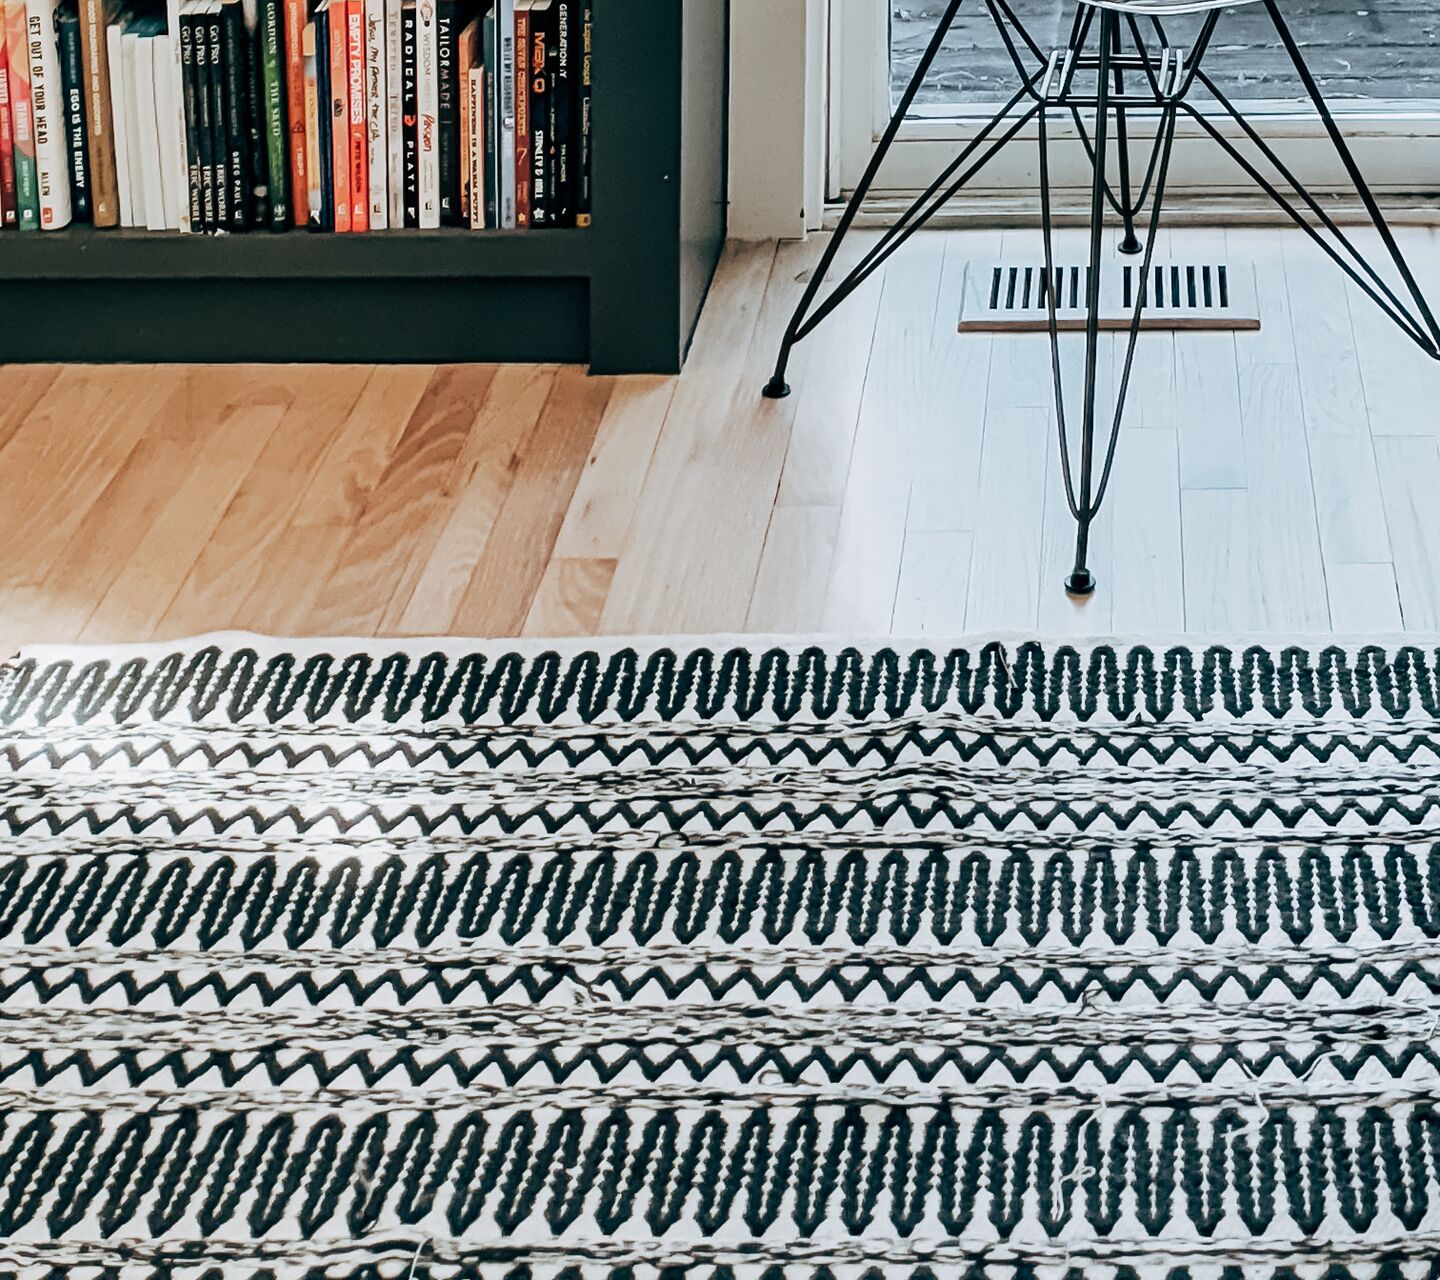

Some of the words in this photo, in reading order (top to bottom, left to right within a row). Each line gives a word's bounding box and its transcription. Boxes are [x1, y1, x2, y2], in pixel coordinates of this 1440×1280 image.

[29, 16, 41, 36] GET
[266, 2, 277, 55] GORDON
[348, 14, 361, 57] EMPTY
[559, 3, 568, 67] GENERATION
[31, 41, 43, 61] OUT
[404, 19, 414, 102] RADICAL
[422, 32, 432, 76] WISDOM
[439, 18, 451, 110] TAILORMADE
[33, 66, 45, 78] OF
[582, 54, 592, 86] Gospel
[35, 84, 46, 110] YOUR
[69, 88, 81, 111] EGO
[270, 80, 280, 104] THE
[349, 58, 363, 126] PROMISES
[531, 78, 546, 94] Q
[71, 113, 82, 125] IS
[470, 79, 479, 136] HAPPINESS
[37, 116, 48, 145] HEAD
[271, 108, 281, 137] SEED
[72, 127, 83, 148] THE
[74, 151, 86, 188] ENEMY
[232, 151, 241, 176] GREG
[406, 140, 416, 193] PLATT
[471, 159, 479, 189] WARM
[40, 171, 51, 197] ALLEN
[233, 180, 243, 204] PAUL
[472, 191, 480, 224] PUPPY
